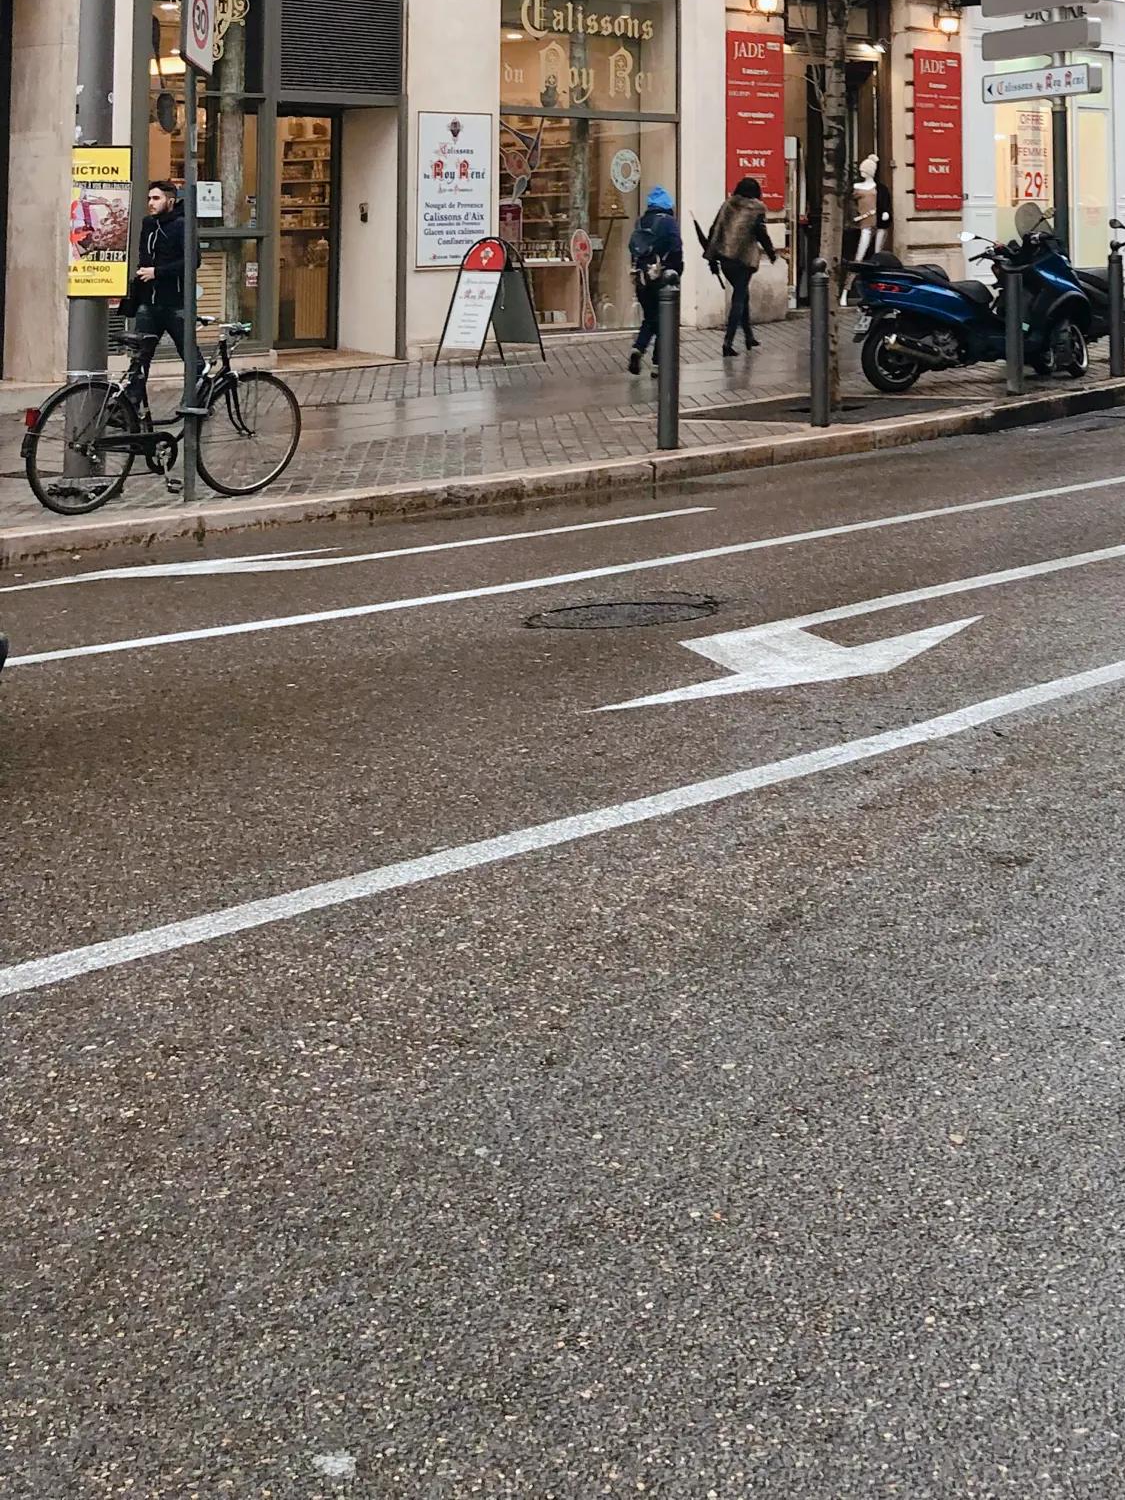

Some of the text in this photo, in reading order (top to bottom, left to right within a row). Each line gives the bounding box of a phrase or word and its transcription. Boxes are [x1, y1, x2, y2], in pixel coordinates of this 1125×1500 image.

[195, 5, 206, 35] 30
[733, 41, 766, 60] JADE
[919, 58, 946, 74] JADE
[424, 202, 447, 210] Nougat
[423, 212, 485, 221] Calissons d'Aix
